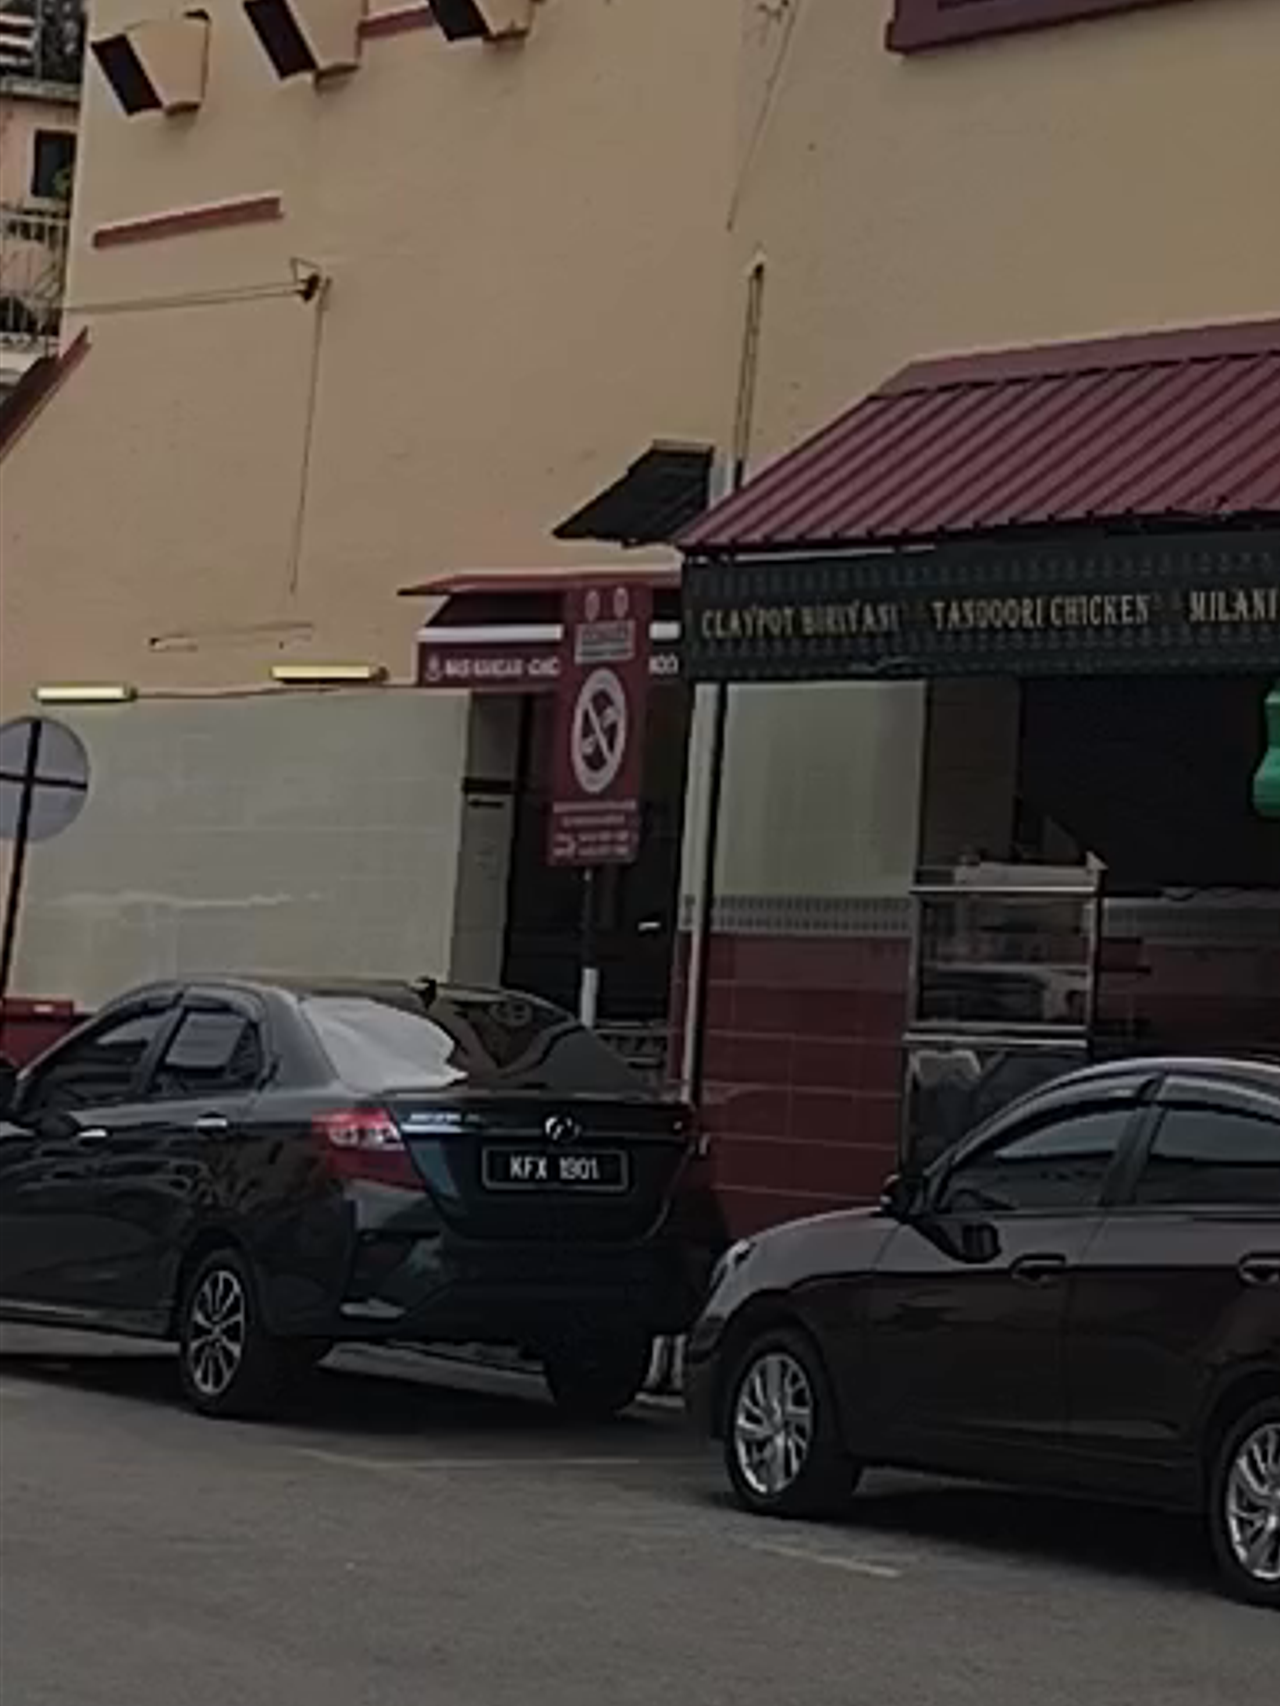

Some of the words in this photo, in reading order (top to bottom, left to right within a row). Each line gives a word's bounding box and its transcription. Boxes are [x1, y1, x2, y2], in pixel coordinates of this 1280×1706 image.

[701, 604, 794, 639] CLAYPOT
[931, 598, 1046, 630] TANDOORI
[1049, 591, 1151, 629] CHICKEN
[1187, 588, 1278, 623] MILANI
[510, 1156, 547, 1180] KFX
